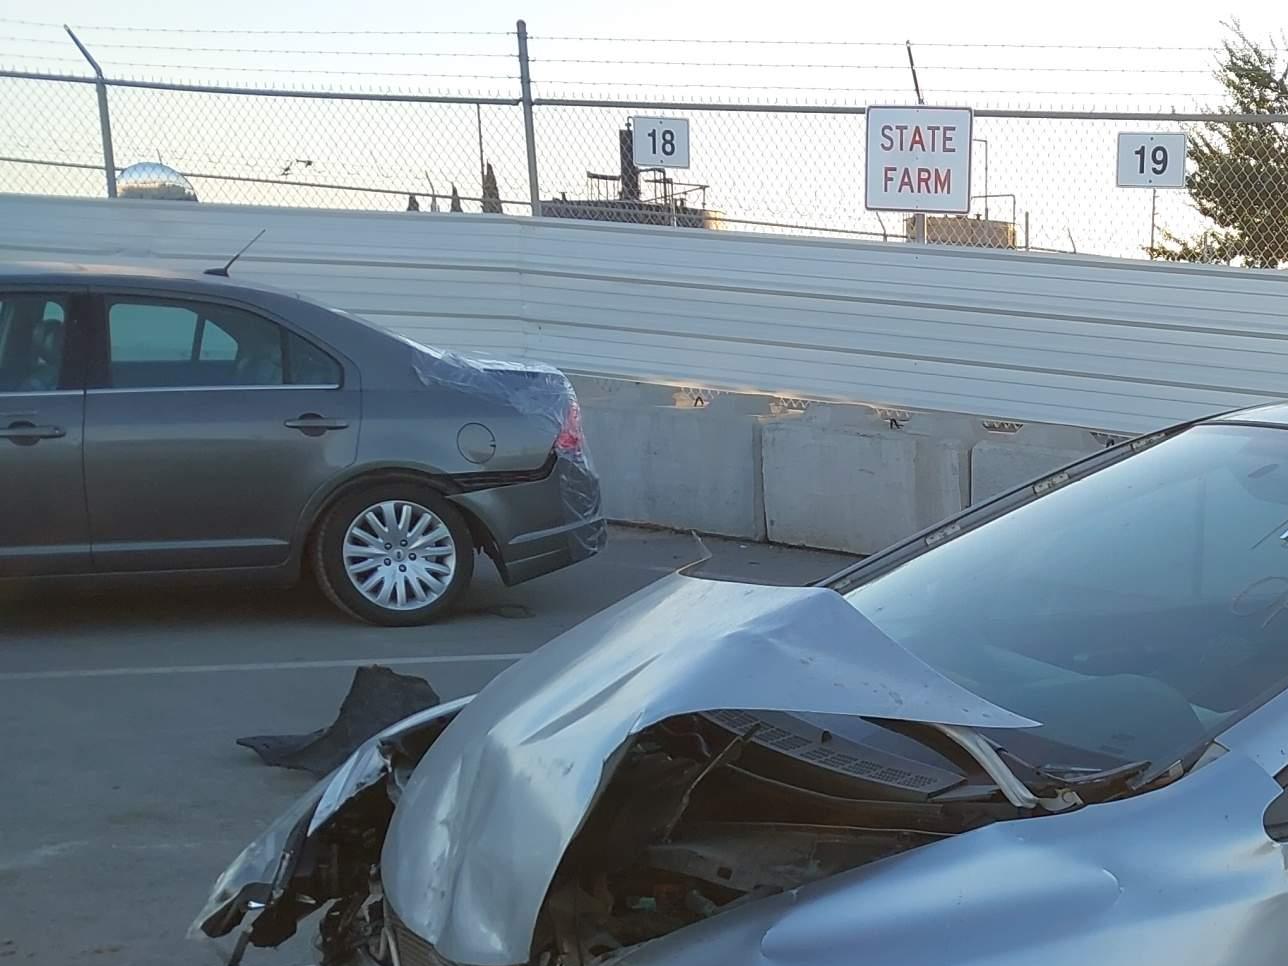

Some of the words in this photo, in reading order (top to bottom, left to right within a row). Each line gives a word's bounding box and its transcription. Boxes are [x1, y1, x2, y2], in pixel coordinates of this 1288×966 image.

[647, 128, 676, 156] 18
[880, 125, 957, 153] STATE
[1134, 145, 1169, 175] 19
[883, 166, 952, 195] FARM
